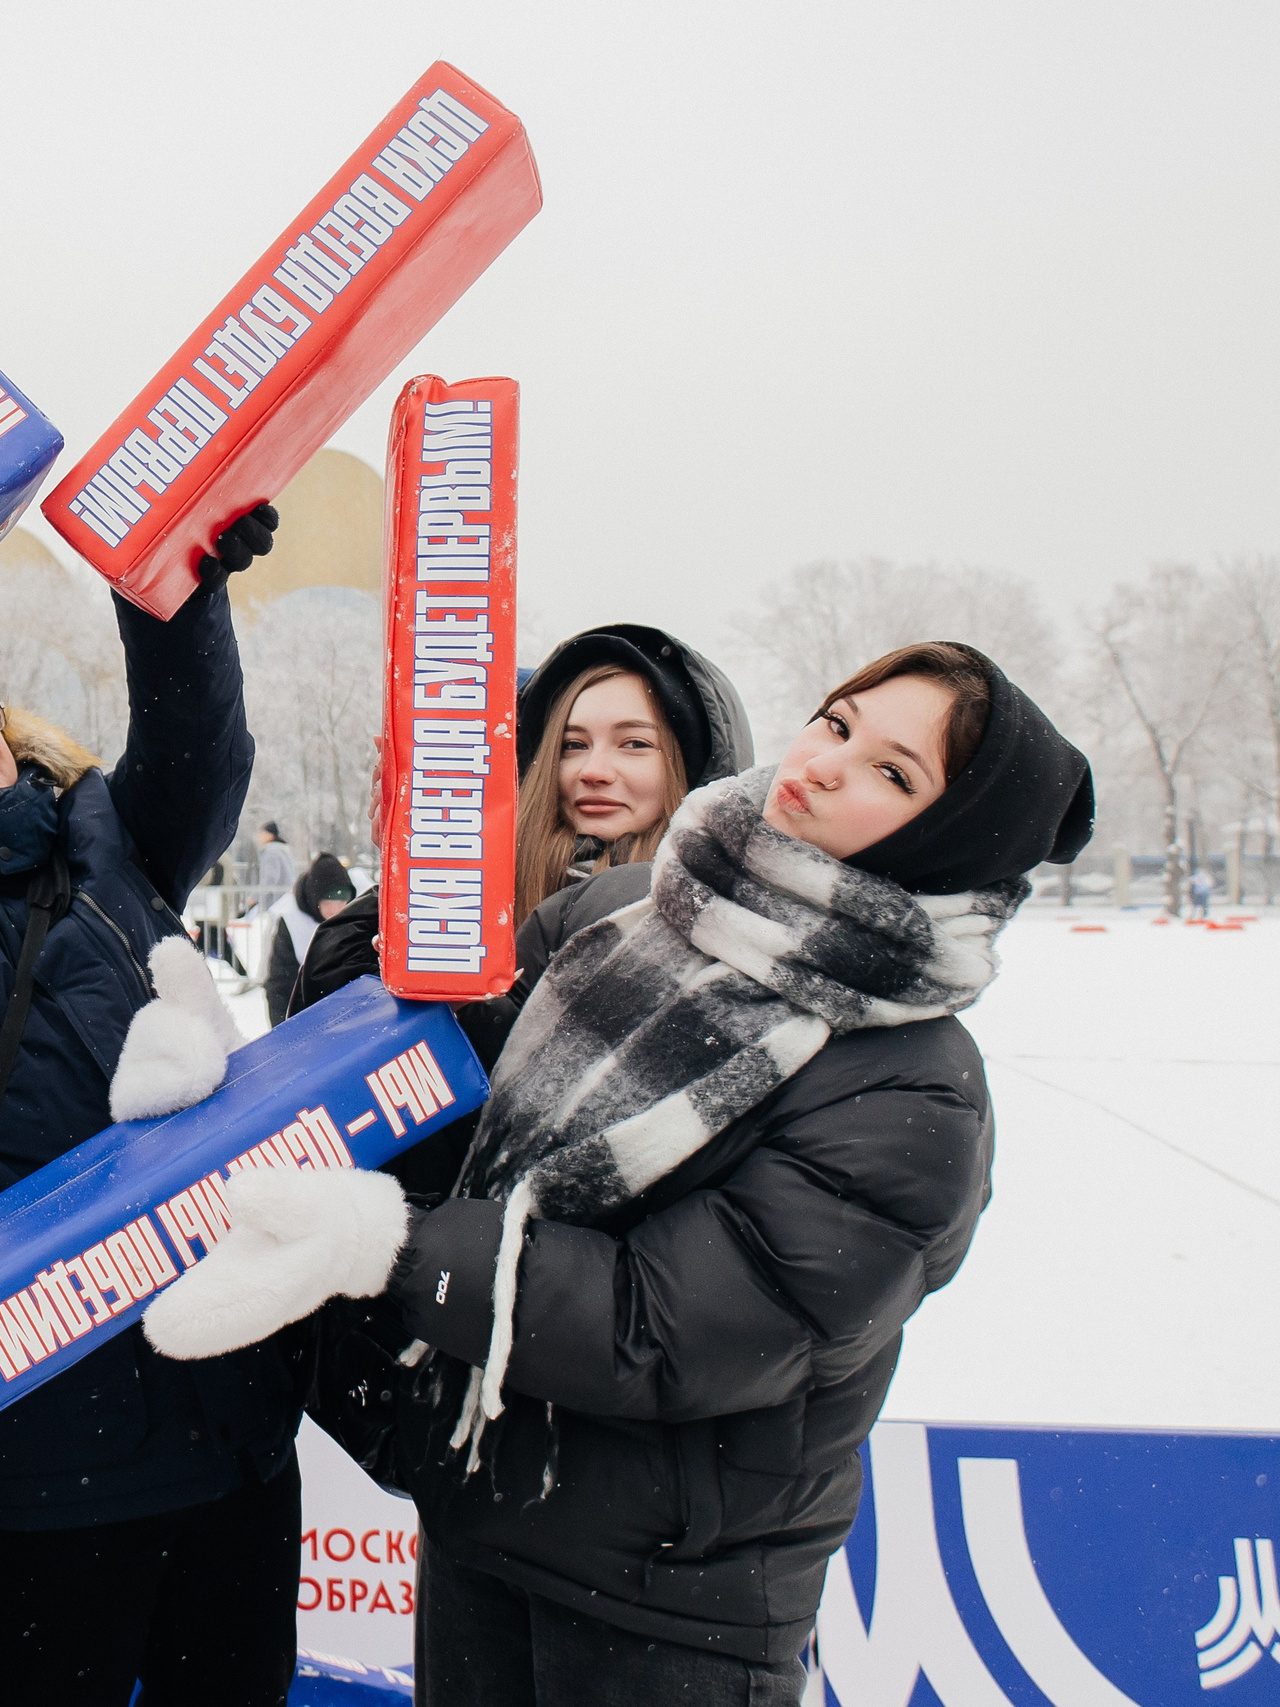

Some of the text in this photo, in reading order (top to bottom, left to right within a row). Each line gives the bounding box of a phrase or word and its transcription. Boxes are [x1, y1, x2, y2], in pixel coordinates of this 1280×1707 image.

[66, 88, 490, 549] ЦСКА ВСЕГДА БУДЕТ ПЕРВЫМ!
[407, 400, 494, 974] ЦСКА ВСЕГДА БУДЕТ ПЕРВЫМ!
[365, 1039, 456, 1139] МЫ
[154, 1170, 233, 1270] МЫ
[435, 1270, 451, 1305] 700
